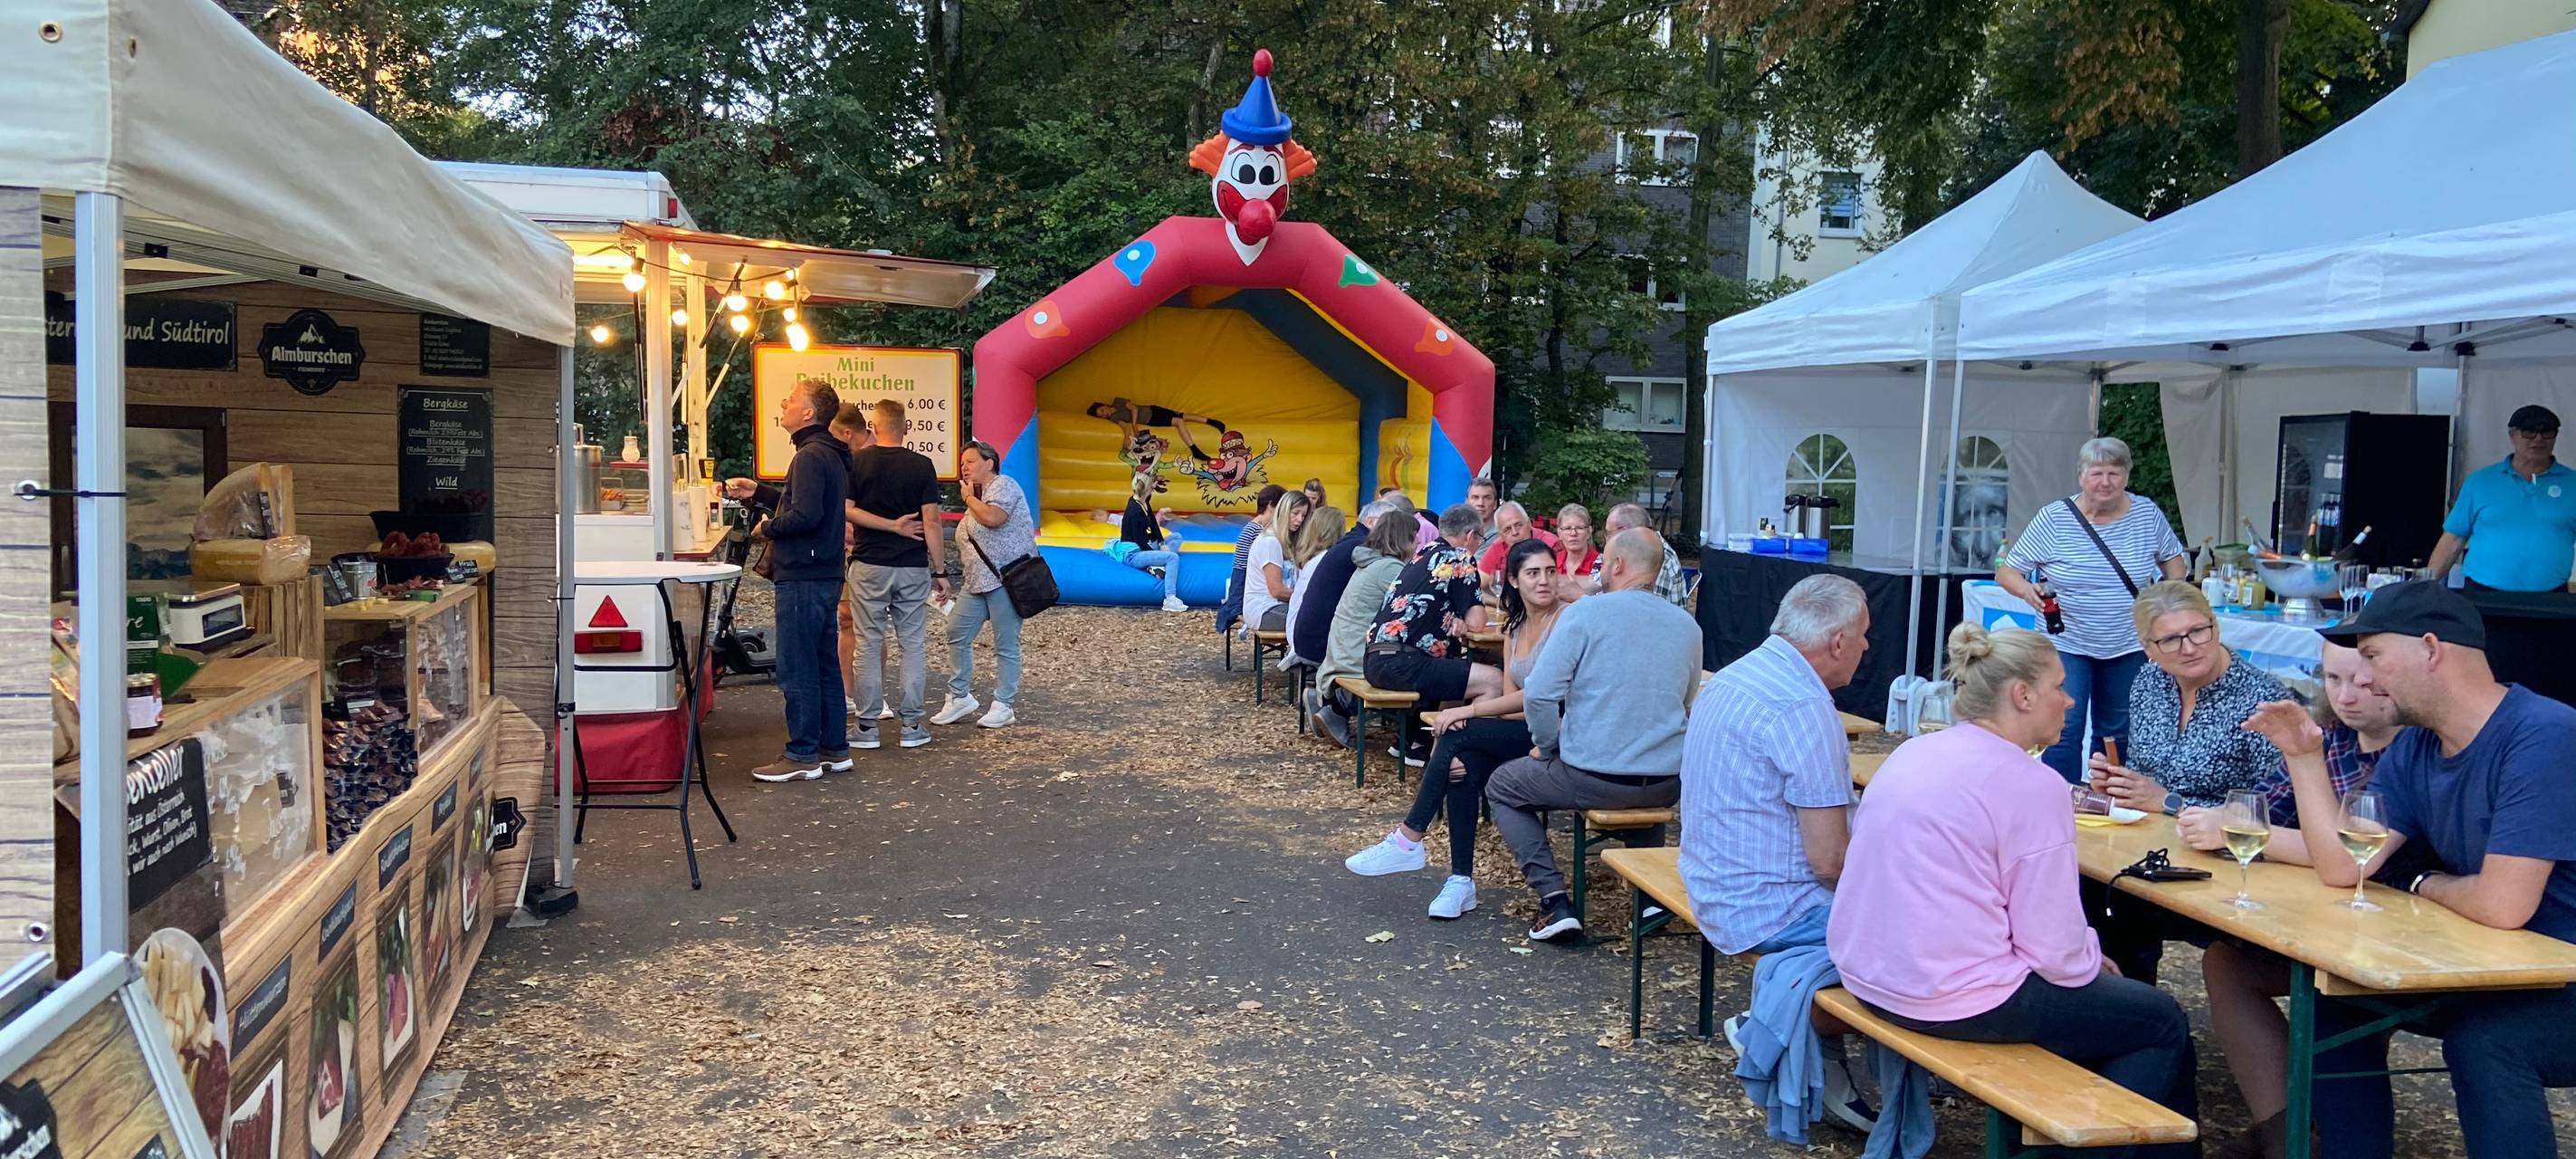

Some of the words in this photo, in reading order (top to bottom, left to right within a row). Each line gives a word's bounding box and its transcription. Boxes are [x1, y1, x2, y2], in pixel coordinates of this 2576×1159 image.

[124, 318, 155, 340] und
[161, 319, 230, 344] Südtirol
[272, 346, 352, 364] Almburschen
[837, 357, 874, 372] Mini
[423, 398, 469, 411] Bergkäse
[908, 398, 934, 410] 6,00
[938, 399, 946, 409] €
[938, 421, 946, 432] €
[938, 442, 945, 453] €
[435, 476, 458, 487] Wild
[126, 746, 185, 805] enteller
